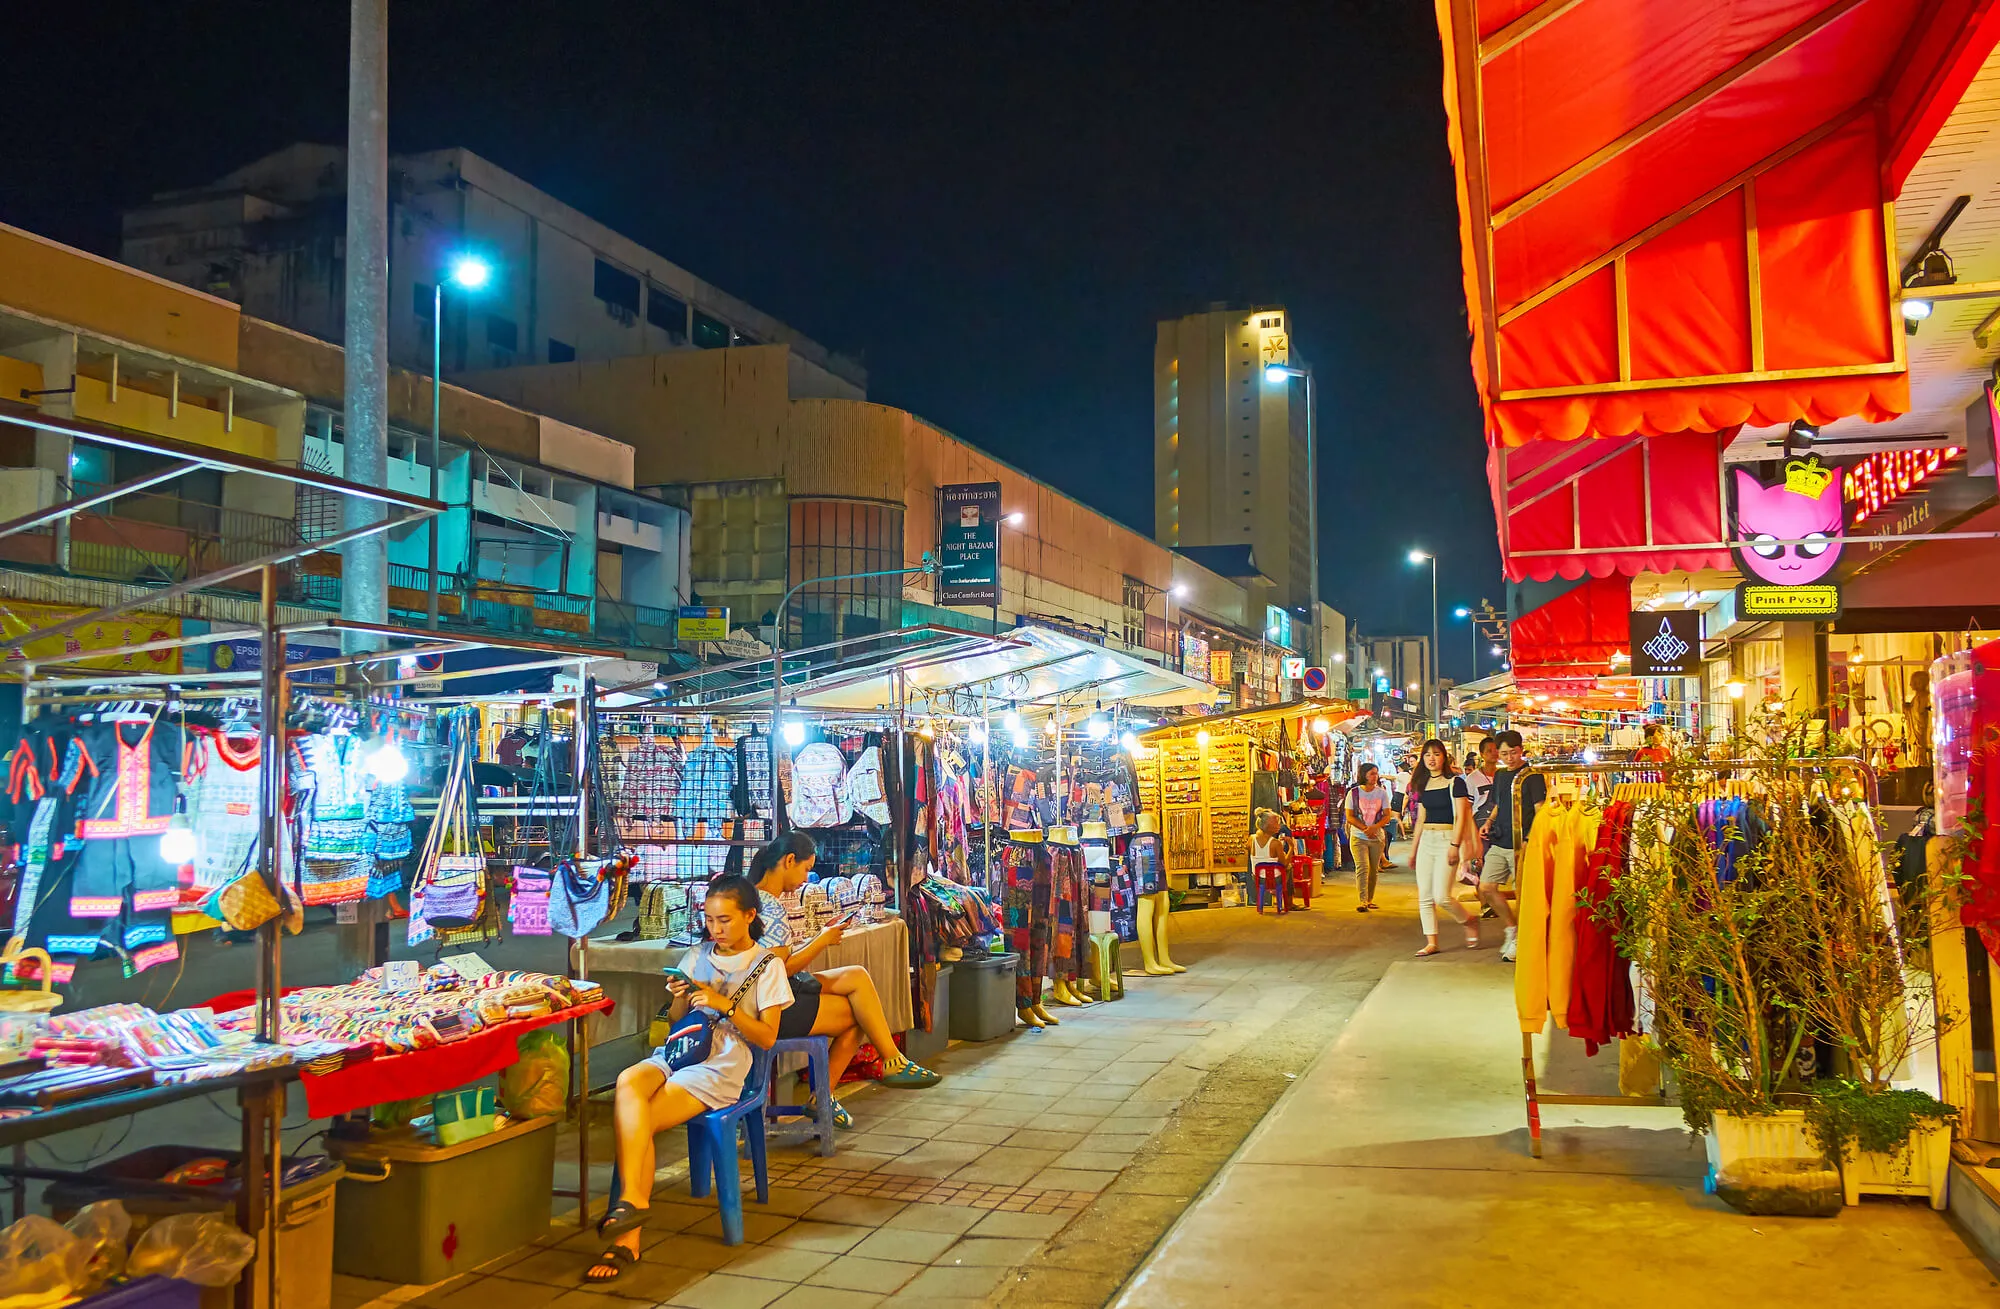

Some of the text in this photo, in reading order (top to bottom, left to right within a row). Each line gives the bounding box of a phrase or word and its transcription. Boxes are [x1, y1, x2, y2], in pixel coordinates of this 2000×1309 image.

[1897, 499, 1930, 535] market
[963, 532, 977, 540] THE
[946, 541, 994, 551] NIGHT BAZAAR
[959, 552, 980, 561] PLACE
[958, 591, 980, 599] Comfort
[1755, 596, 1785, 604] Pink
